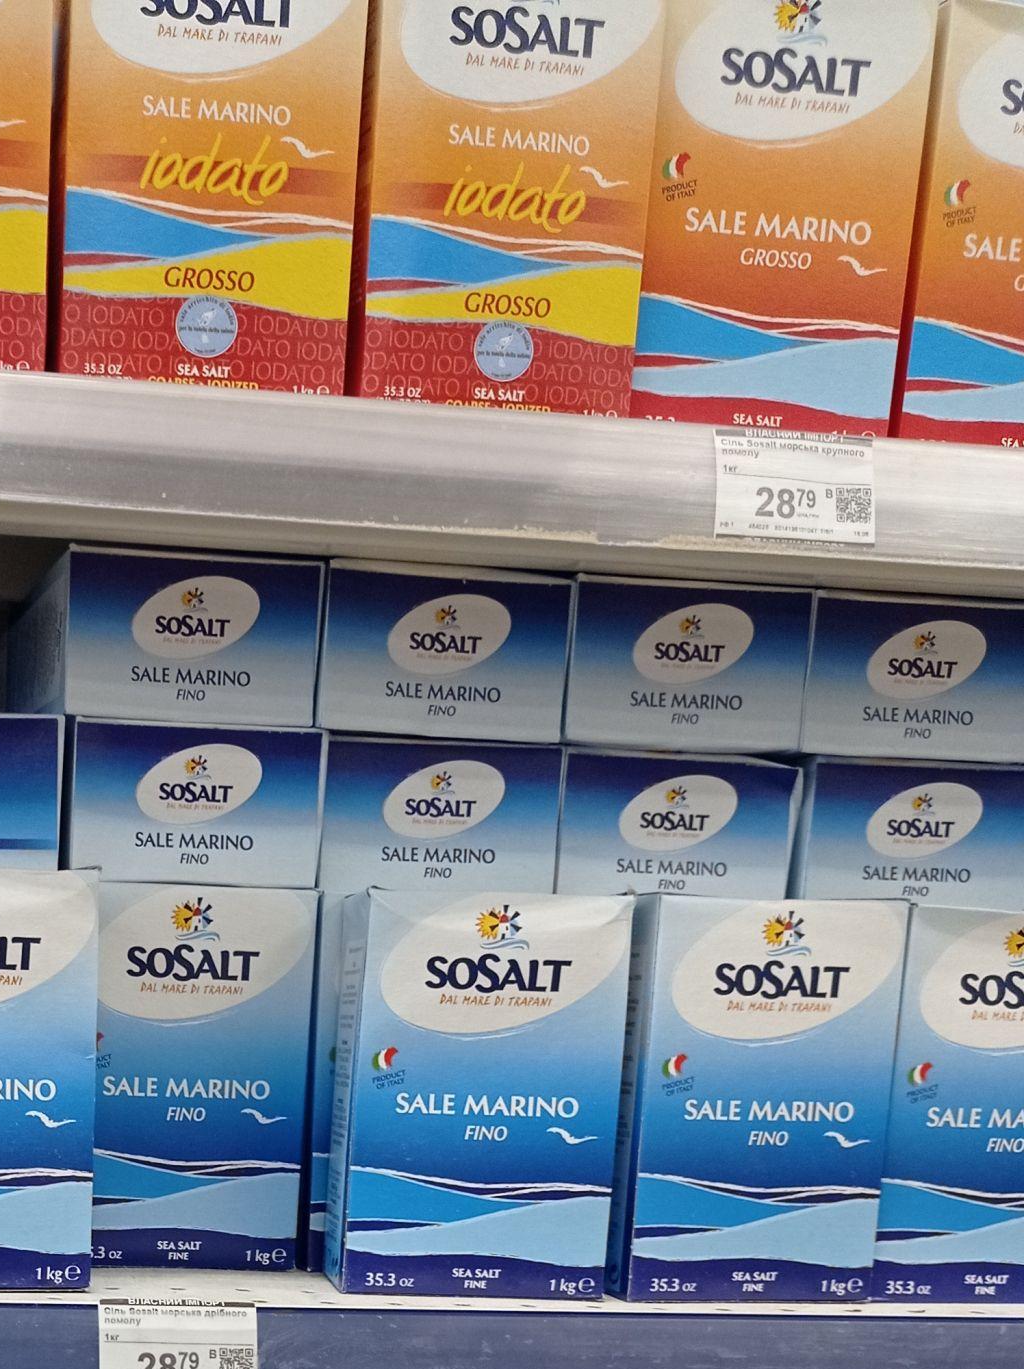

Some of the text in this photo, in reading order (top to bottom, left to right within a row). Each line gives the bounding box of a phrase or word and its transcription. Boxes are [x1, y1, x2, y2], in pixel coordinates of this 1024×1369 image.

[157, 24, 282, 46] DAL MARE DI TRAPANI
[449, 6, 605, 58] SOSALT
[720, 47, 872, 97] SOSALT
[142, 95, 291, 127] SALE MARINO
[448, 124, 590, 157] SALE MARINO
[139, 132, 289, 204] iodato
[443, 161, 586, 234] iodato
[662, 179, 697, 195] PRODUCT
[665, 188, 696, 201] OF ITALY
[684, 207, 872, 246] SALE MARINO
[740, 248, 812, 270] GROSSO
[164, 266, 255, 293] GROSSO
[464, 292, 551, 318] GROSSO
[83, 362, 123, 375] 35.3 OZ
[474, 386, 525, 401] SEA SALT
[779, 443, 866, 459] морська крупного
[754, 486, 816, 519] 28 79
[155, 615, 230, 638] SOSALT
[409, 631, 482, 655] SOSALT
[654, 641, 725, 663] SOSALT
[131, 666, 251, 688] SALE MARINO
[887, 657, 958, 679] SOSALT
[176, 689, 206, 702] FINO
[385, 681, 501, 703] SALE MARINO
[630, 691, 743, 711] SALE MARINO
[159, 782, 233, 804] SOSALT
[886, 818, 955, 838] SOSALT
[126, 943, 261, 982] SOSALT
[425, 953, 572, 993] SOSALT
[713, 960, 851, 1000] SOSALT
[684, 1100, 855, 1123] SALE MARINO
[104, 1317, 141, 1327] помолу
[204, 1309, 247, 1320] дрібного
[178, 1351, 200, 1369] 79
